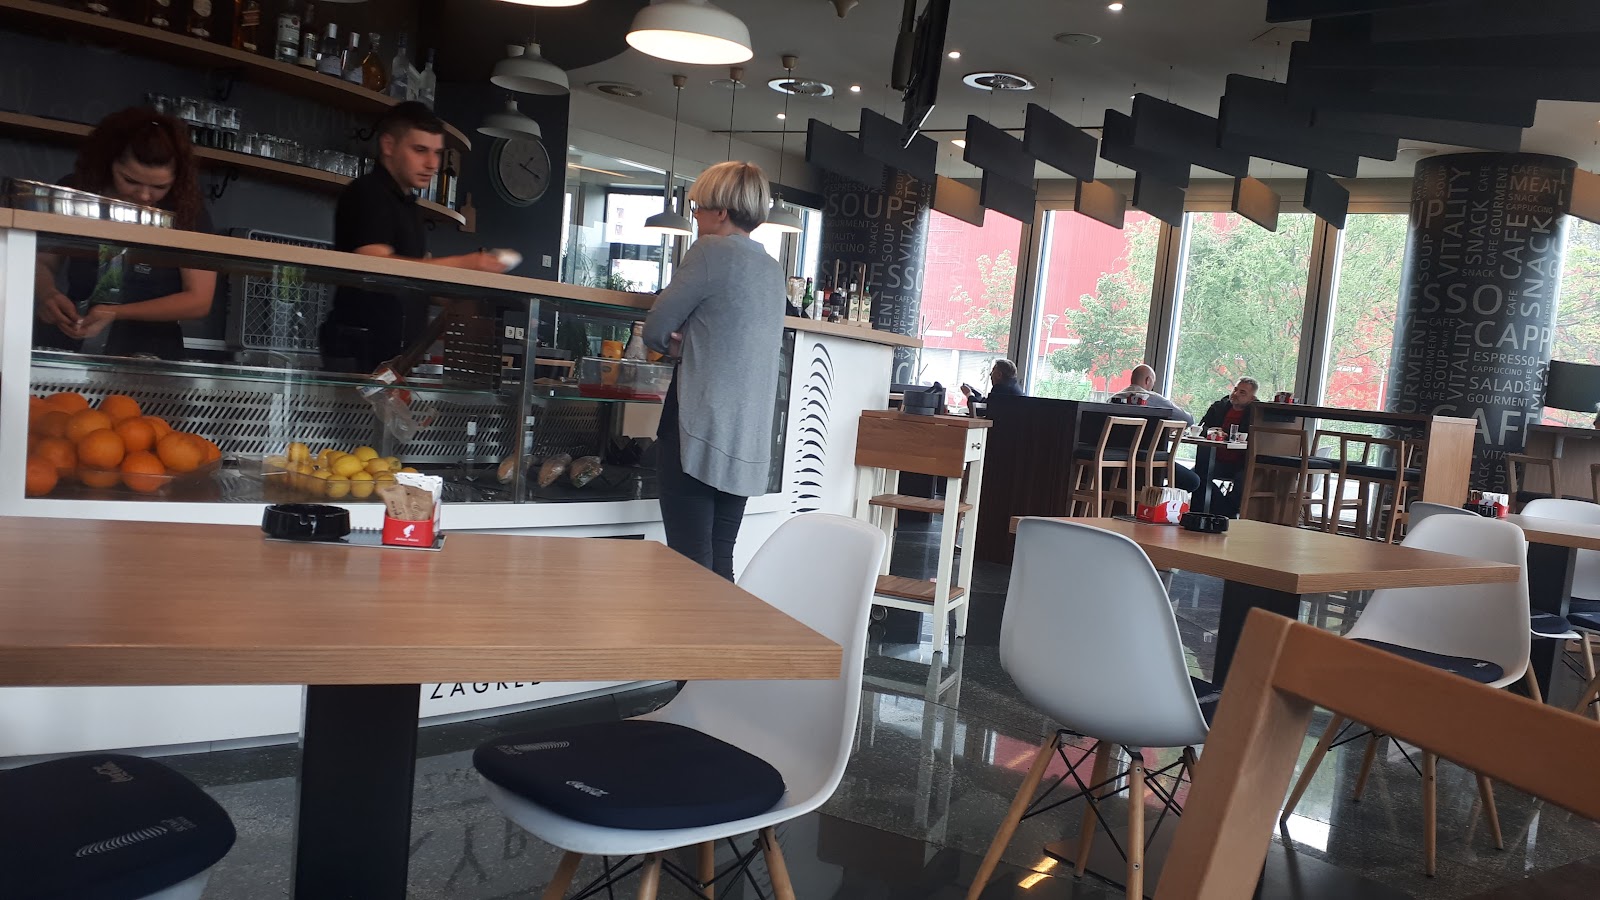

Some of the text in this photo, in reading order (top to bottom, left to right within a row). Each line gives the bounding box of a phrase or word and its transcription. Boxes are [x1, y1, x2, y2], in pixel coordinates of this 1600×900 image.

[1436, 166, 1448, 198] SOUP
[1477, 165, 1490, 192] CAFE
[1512, 164, 1540, 174] CAFE
[1507, 193, 1539, 203] SNACK
[1509, 175, 1560, 195] MEAT
[826, 193, 904, 220] SOUP
[1491, 167, 1509, 236] GOURMENT
[1505, 203, 1553, 214] CAPPUCCINO
[898, 173, 919, 262] VITALITY
[1436, 167, 1471, 280] VITALITY
[868, 221, 880, 254] SNACK
[881, 223, 895, 262] SOUP
[1464, 200, 1490, 265] SNACK
[1418, 233, 1434, 282] SOUP
[1486, 239, 1499, 266] CAFE
[1500, 214, 1528, 280] CAFE
[1461, 268, 1496, 278] SNACK
[1520, 216, 1553, 318] SNACK
[1506, 289, 1519, 317] CAFE
[1429, 317, 1455, 328] CAFE
[1422, 330, 1438, 389] GOURMENT
[1433, 349, 1449, 390] SOUP
[1447, 317, 1474, 401] VITALITY
[1471, 364, 1522, 377] CAPPUCCINO
[1473, 351, 1535, 367] ESPRESSO
[1469, 376, 1524, 394] SALAD
[1523, 369, 1533, 392] CAFE
[1530, 357, 1547, 411] MEAT
[1419, 390, 1446, 401] CAFE
[1467, 392, 1530, 408] GOURMENT
